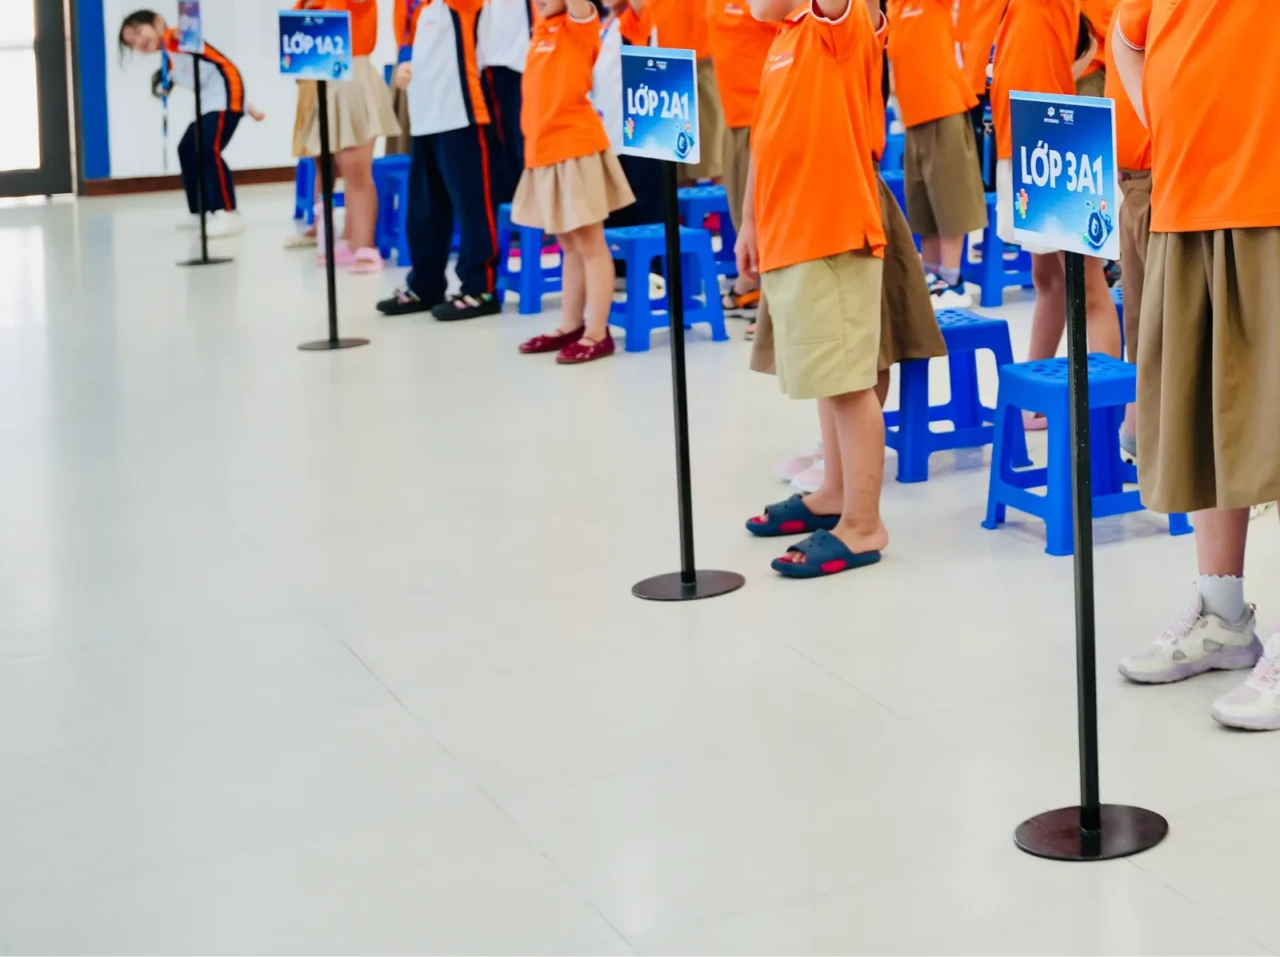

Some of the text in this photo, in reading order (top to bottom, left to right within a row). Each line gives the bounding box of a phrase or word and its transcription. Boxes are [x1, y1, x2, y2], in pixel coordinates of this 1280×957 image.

[283, 31, 344, 55] LỚP 1A2
[627, 83, 689, 120] LỚP 2A1
[1021, 140, 1103, 196] LỚP 3A1
